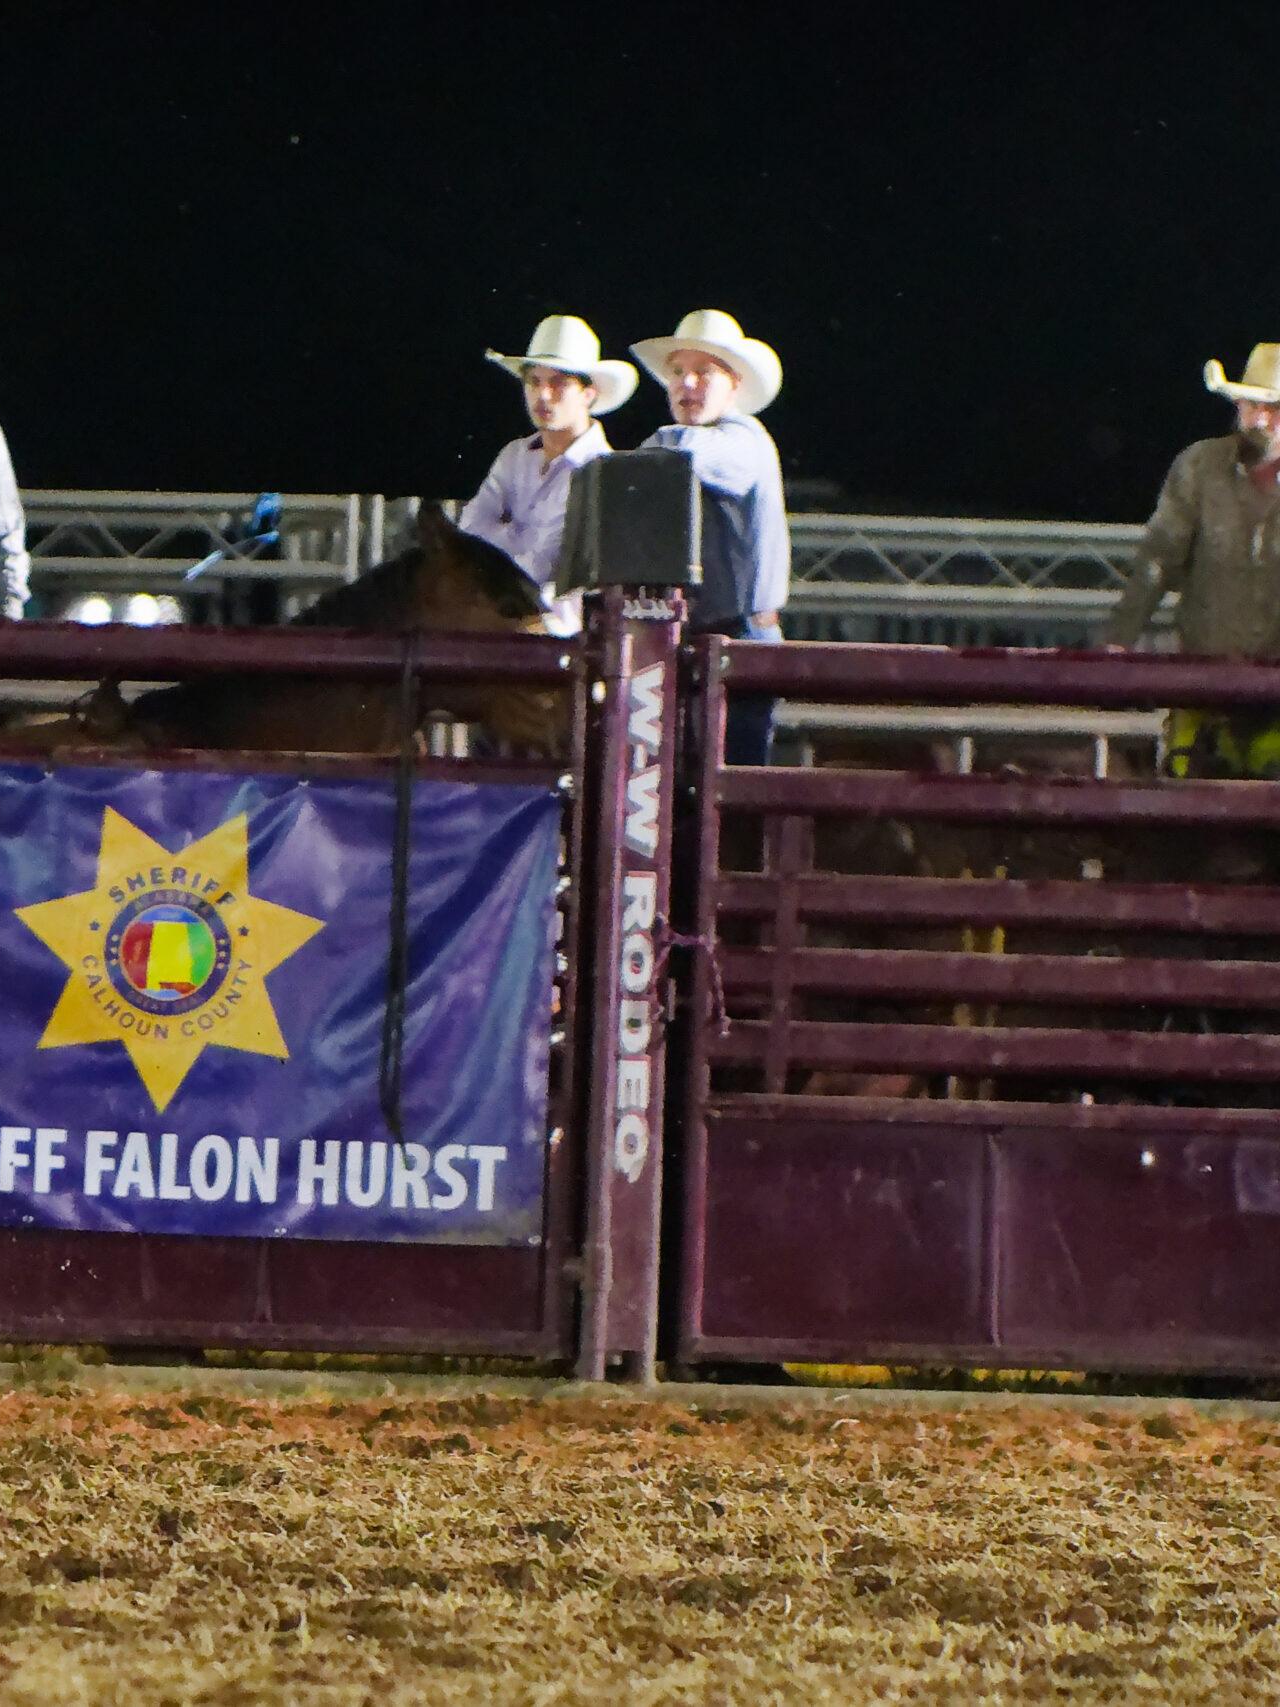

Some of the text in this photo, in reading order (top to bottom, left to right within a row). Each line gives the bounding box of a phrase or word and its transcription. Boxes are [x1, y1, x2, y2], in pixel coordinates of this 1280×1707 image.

[109, 866, 235, 905] SHERIFF
[615, 660, 665, 1183] W-W RODEO
[83, 955, 252, 1039] CALHOUN COUNTY
[83, 1130, 280, 1203] FALON
[297, 1138, 507, 1211] HURST
